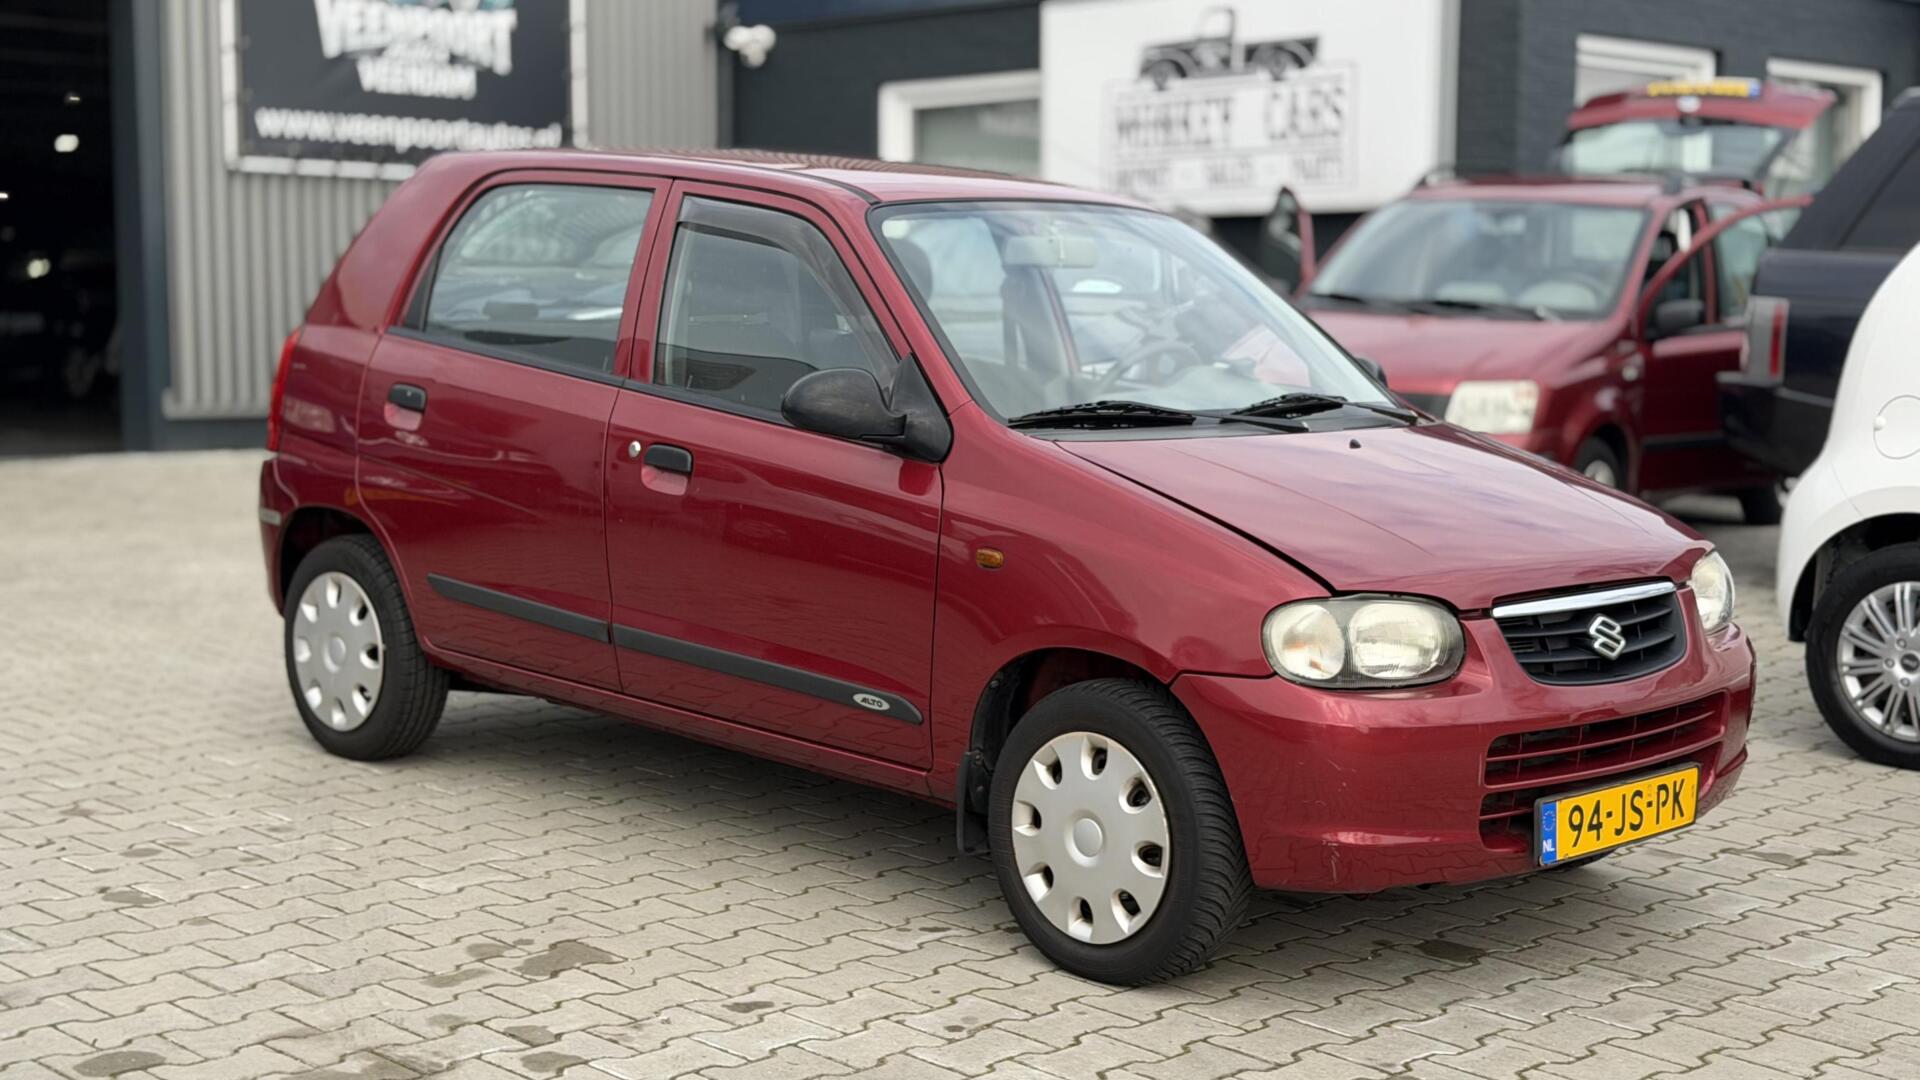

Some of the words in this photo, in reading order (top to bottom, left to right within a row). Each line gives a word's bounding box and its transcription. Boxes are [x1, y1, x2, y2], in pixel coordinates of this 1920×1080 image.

[861, 697, 883, 708] ALTO
[1568, 778, 1686, 848] 94-JS-PK
[1542, 838, 1555, 853] NL
